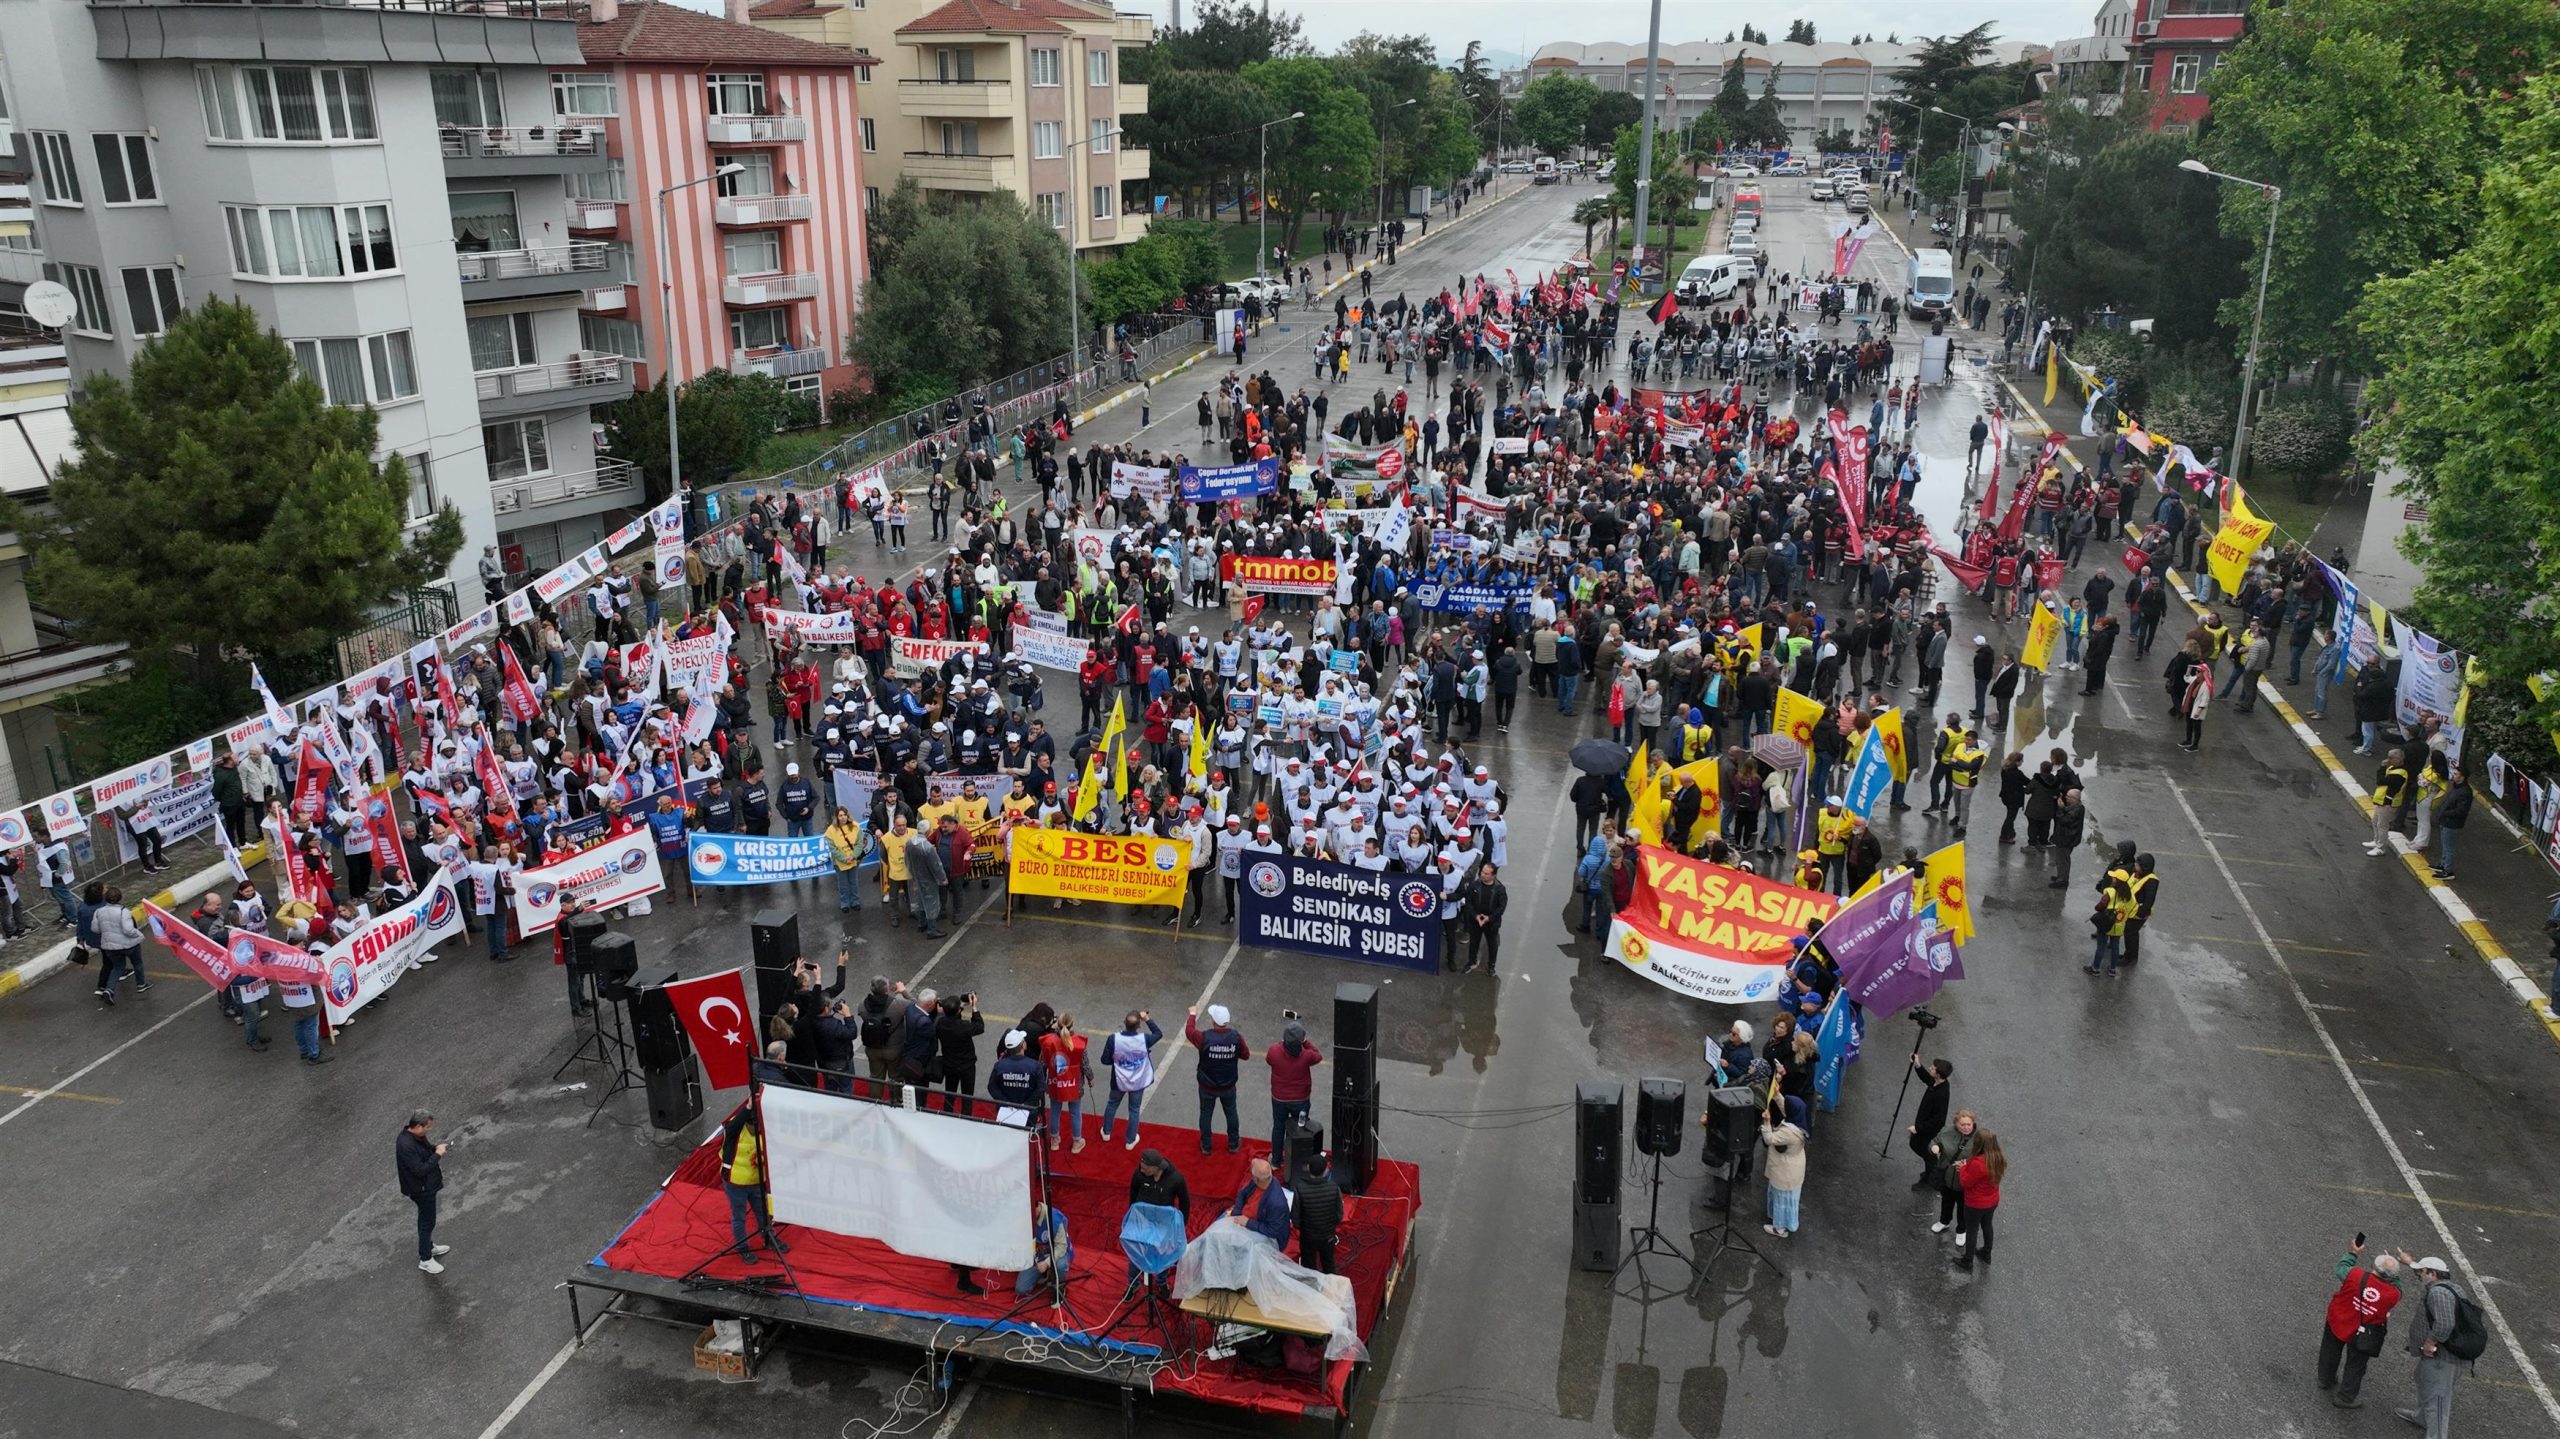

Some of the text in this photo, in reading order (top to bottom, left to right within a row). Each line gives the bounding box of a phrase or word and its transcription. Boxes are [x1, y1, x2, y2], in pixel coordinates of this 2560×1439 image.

[1206, 476, 1252, 488] Federasyonu
[1233, 558, 1338, 582] tmmob
[1448, 595, 1506, 604] DESTEKLEME
[1449, 586, 1533, 596] ÇAĞDAŞ YAŞA
[1448, 604, 1503, 613] BALIKSİR
[812, 631, 854, 641] BALIKESİR
[160, 806, 197, 830] TALEP
[173, 812, 216, 837] KRİSTAL
[734, 838, 829, 856] KRİSTAL-İ
[1060, 837, 1147, 866] BES
[1018, 860, 1177, 888] BÜRO EMEKÇİLERİ SENDİKASI
[1293, 867, 1391, 900] Belediye-İş
[1059, 881, 1147, 899] BALIKESİR ŞUBESİ
[1646, 854, 1831, 930] YAŞASIN
[1292, 895, 1391, 926] SENDİKASI
[1260, 914, 1425, 960] BALIKESİR ŞUBESİ
[1658, 902, 1792, 953] 1 MAYIS
[1651, 962, 1741, 999] BALIKESİR ŞUBESİ
[1672, 963, 1731, 985] EĞİTİM SEN
[1743, 981, 1773, 995] KESK
[1209, 1044, 1236, 1054] KRİSTAL-İŞ
[1003, 1072, 1031, 1083] KRİSTAL-İŞ
